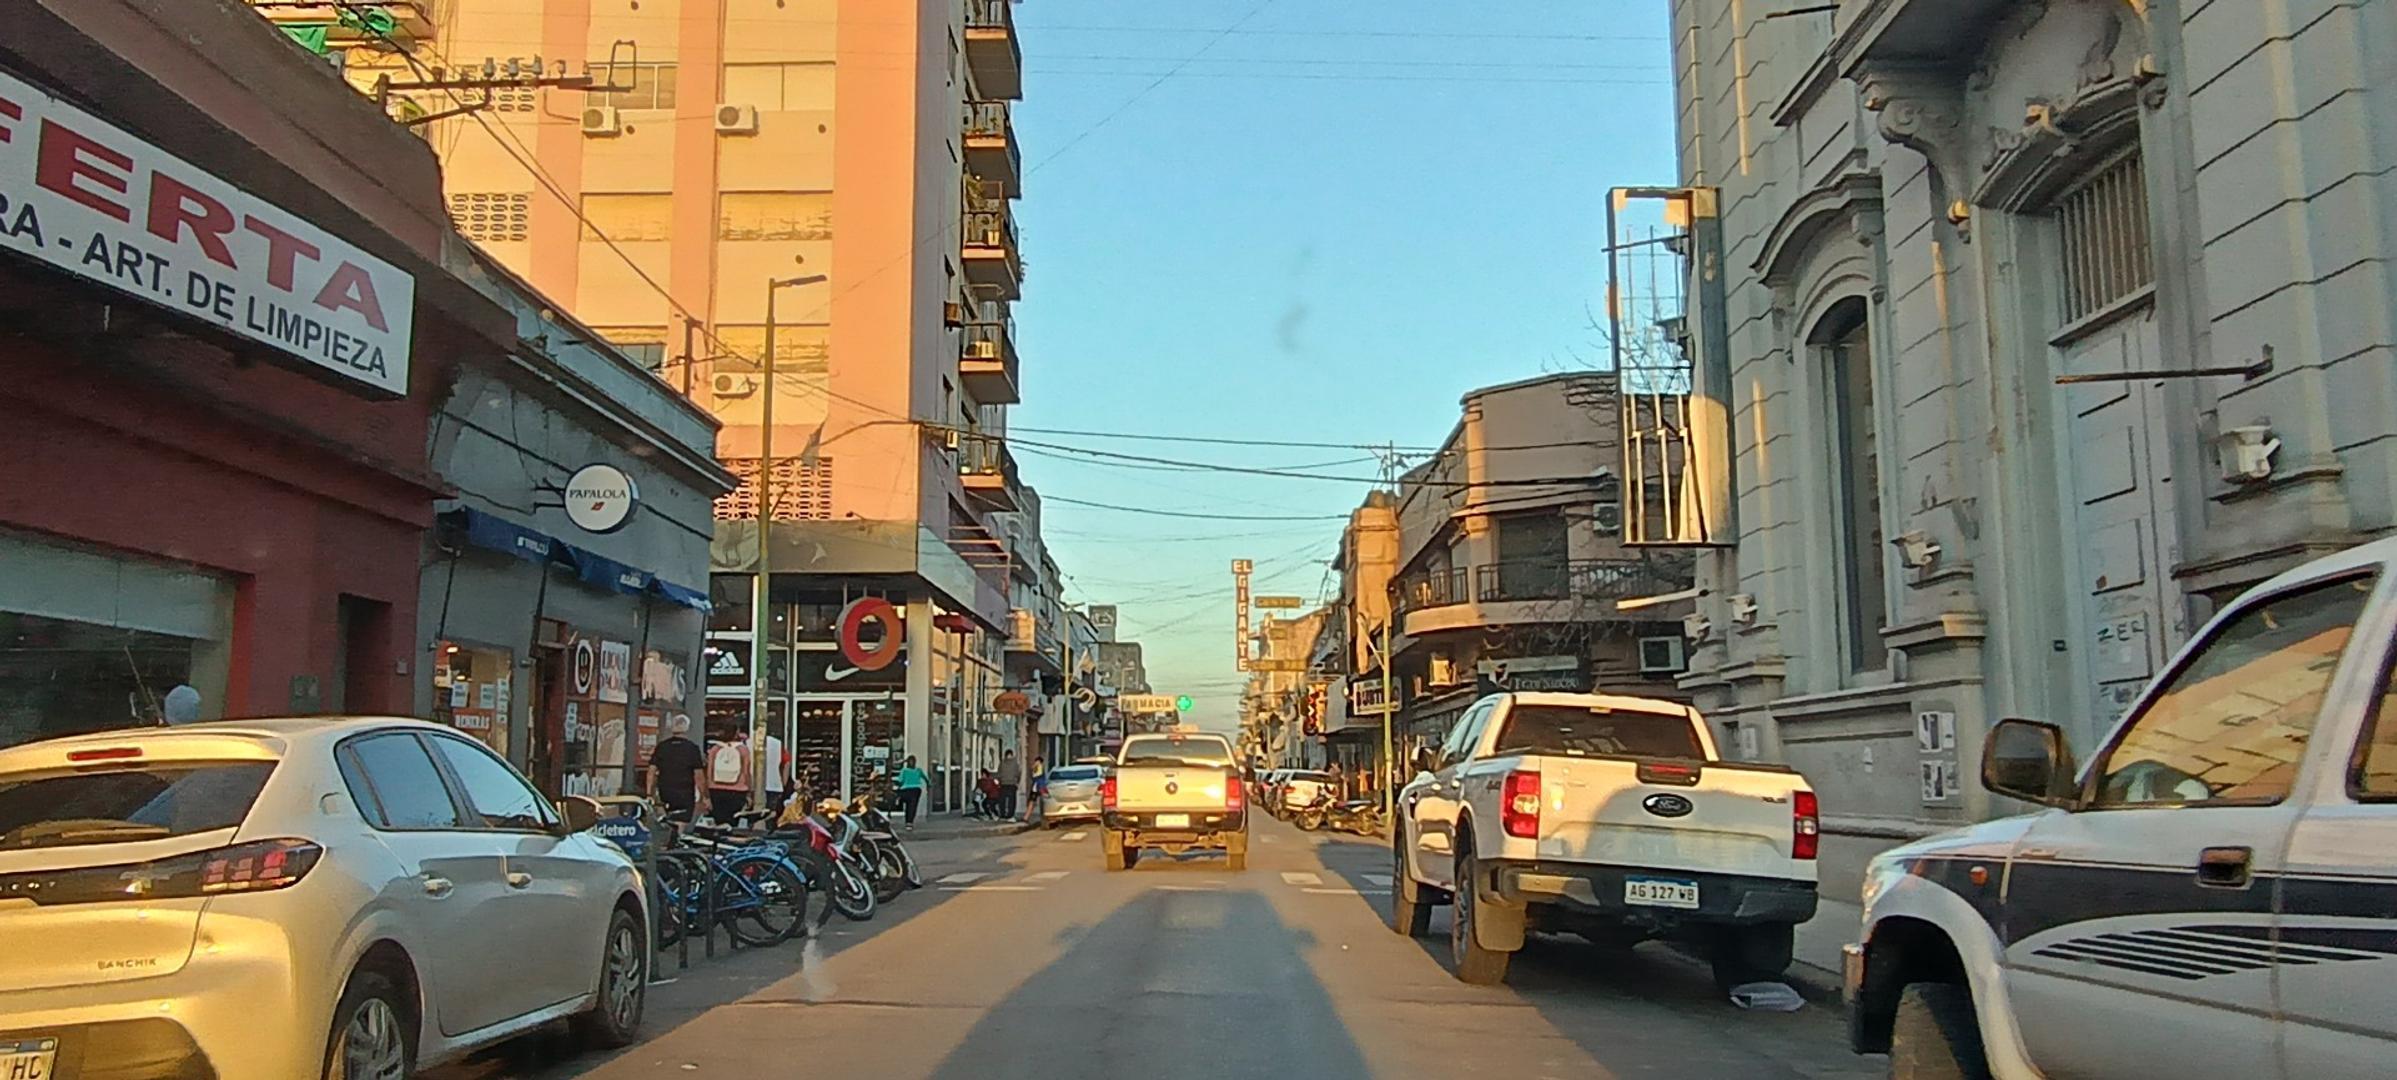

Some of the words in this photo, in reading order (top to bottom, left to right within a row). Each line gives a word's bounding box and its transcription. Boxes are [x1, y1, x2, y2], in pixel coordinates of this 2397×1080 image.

[0, 96, 389, 334] ERTA
[82, 232, 172, 297] ART.
[187, 270, 236, 321] DE
[247, 295, 387, 379] LIMPIEZA
[569, 489, 626, 499] PAPALOLA
[1233, 560, 1251, 572] EL
[1238, 574, 1248, 671] GIGANTE
[1121, 698, 1171, 709] FARMACIA
[1630, 885, 1646, 897] AG
[1651, 886, 1674, 898] 127
[11, 1056, 41, 1080] HC
